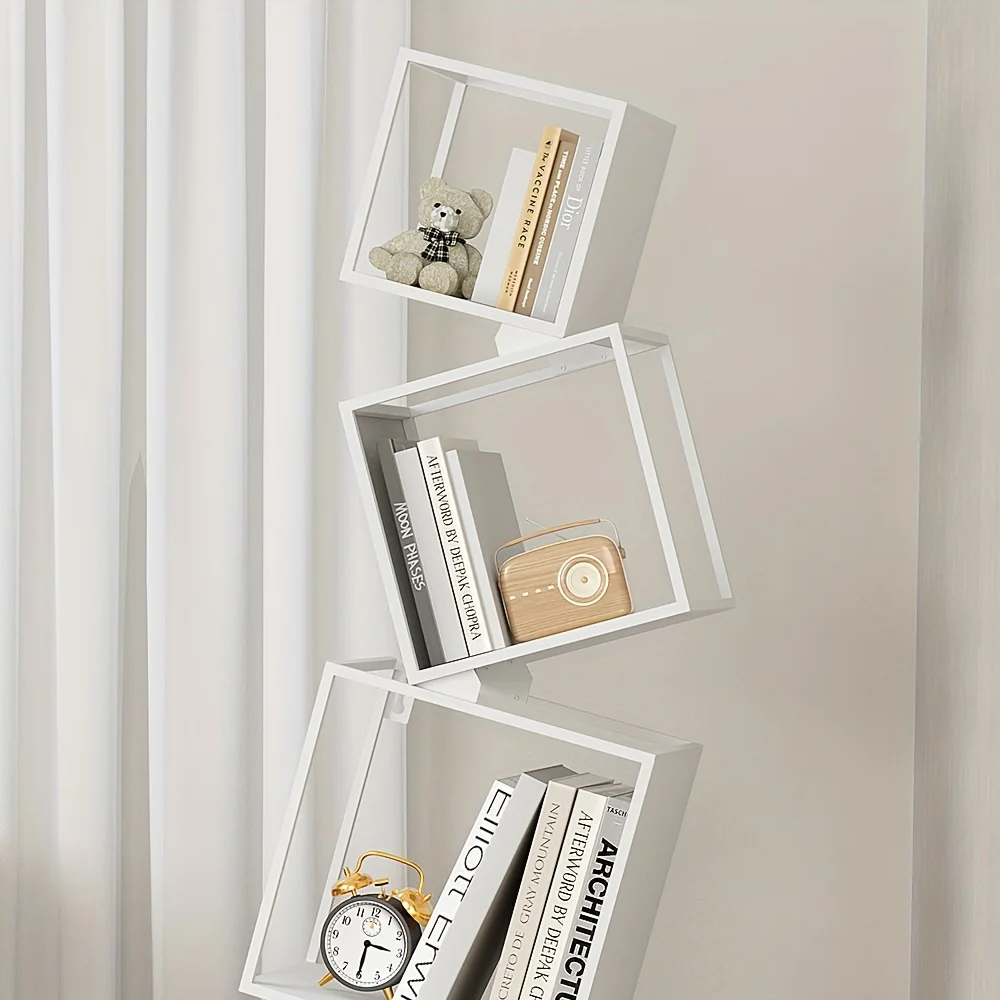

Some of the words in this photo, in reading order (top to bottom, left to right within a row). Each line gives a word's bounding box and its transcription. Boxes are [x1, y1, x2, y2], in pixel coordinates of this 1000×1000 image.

[559, 150, 569, 169] TIME
[527, 165, 546, 214] VACCINE
[550, 179, 560, 204] PLACE
[541, 208, 553, 236] NORDIC
[560, 195, 583, 230] Dior
[517, 219, 532, 249] RACE
[532, 236, 545, 265] CUISINE
[426, 454, 454, 527] AFTERWORD
[394, 501, 415, 539] MOON
[446, 528, 459, 547] BY
[404, 542, 426, 591] PHASES
[450, 547, 470, 593] DEEPAK
[461, 594, 482, 641] CHOPRA
[554, 810, 593, 902] AFTERWORD
[512, 930, 525, 950] DE
[519, 883, 540, 924] GRAY
[530, 802, 560, 884] MOUNTAIN
[342, 916, 351, 926] 10
[357, 907, 364, 917] 11
[371, 907, 381, 918] 12
[388, 916, 392, 925] 1
[550, 905, 567, 927] BY
[333, 930, 339, 939] 9
[396, 931, 402, 940] 2
[333, 946, 339, 956] 8
[396, 949, 402, 958] 3
[536, 928, 562, 984] DEEPAK
[343, 961, 348, 970] 7
[374, 971, 380, 980] 5
[387, 964, 392, 972] 4
